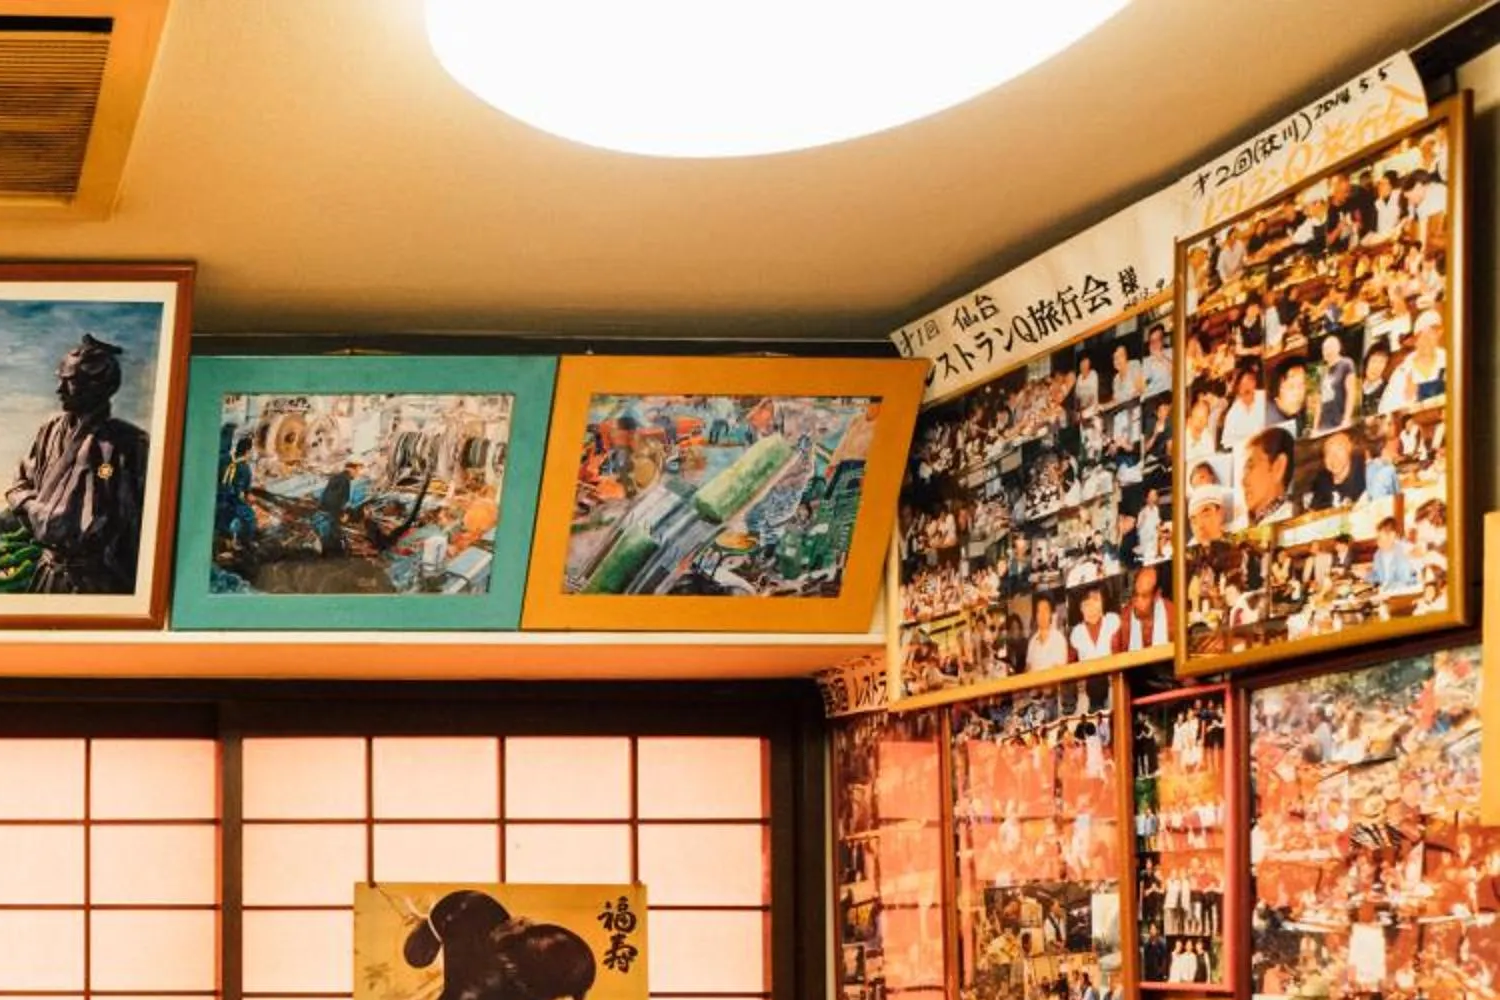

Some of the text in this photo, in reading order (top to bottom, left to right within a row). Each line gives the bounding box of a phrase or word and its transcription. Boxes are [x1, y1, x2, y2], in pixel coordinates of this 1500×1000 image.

[1117, 265, 1141, 296] 様
[952, 292, 1001, 331] 仙台
[596, 895, 639, 974] 福寿
